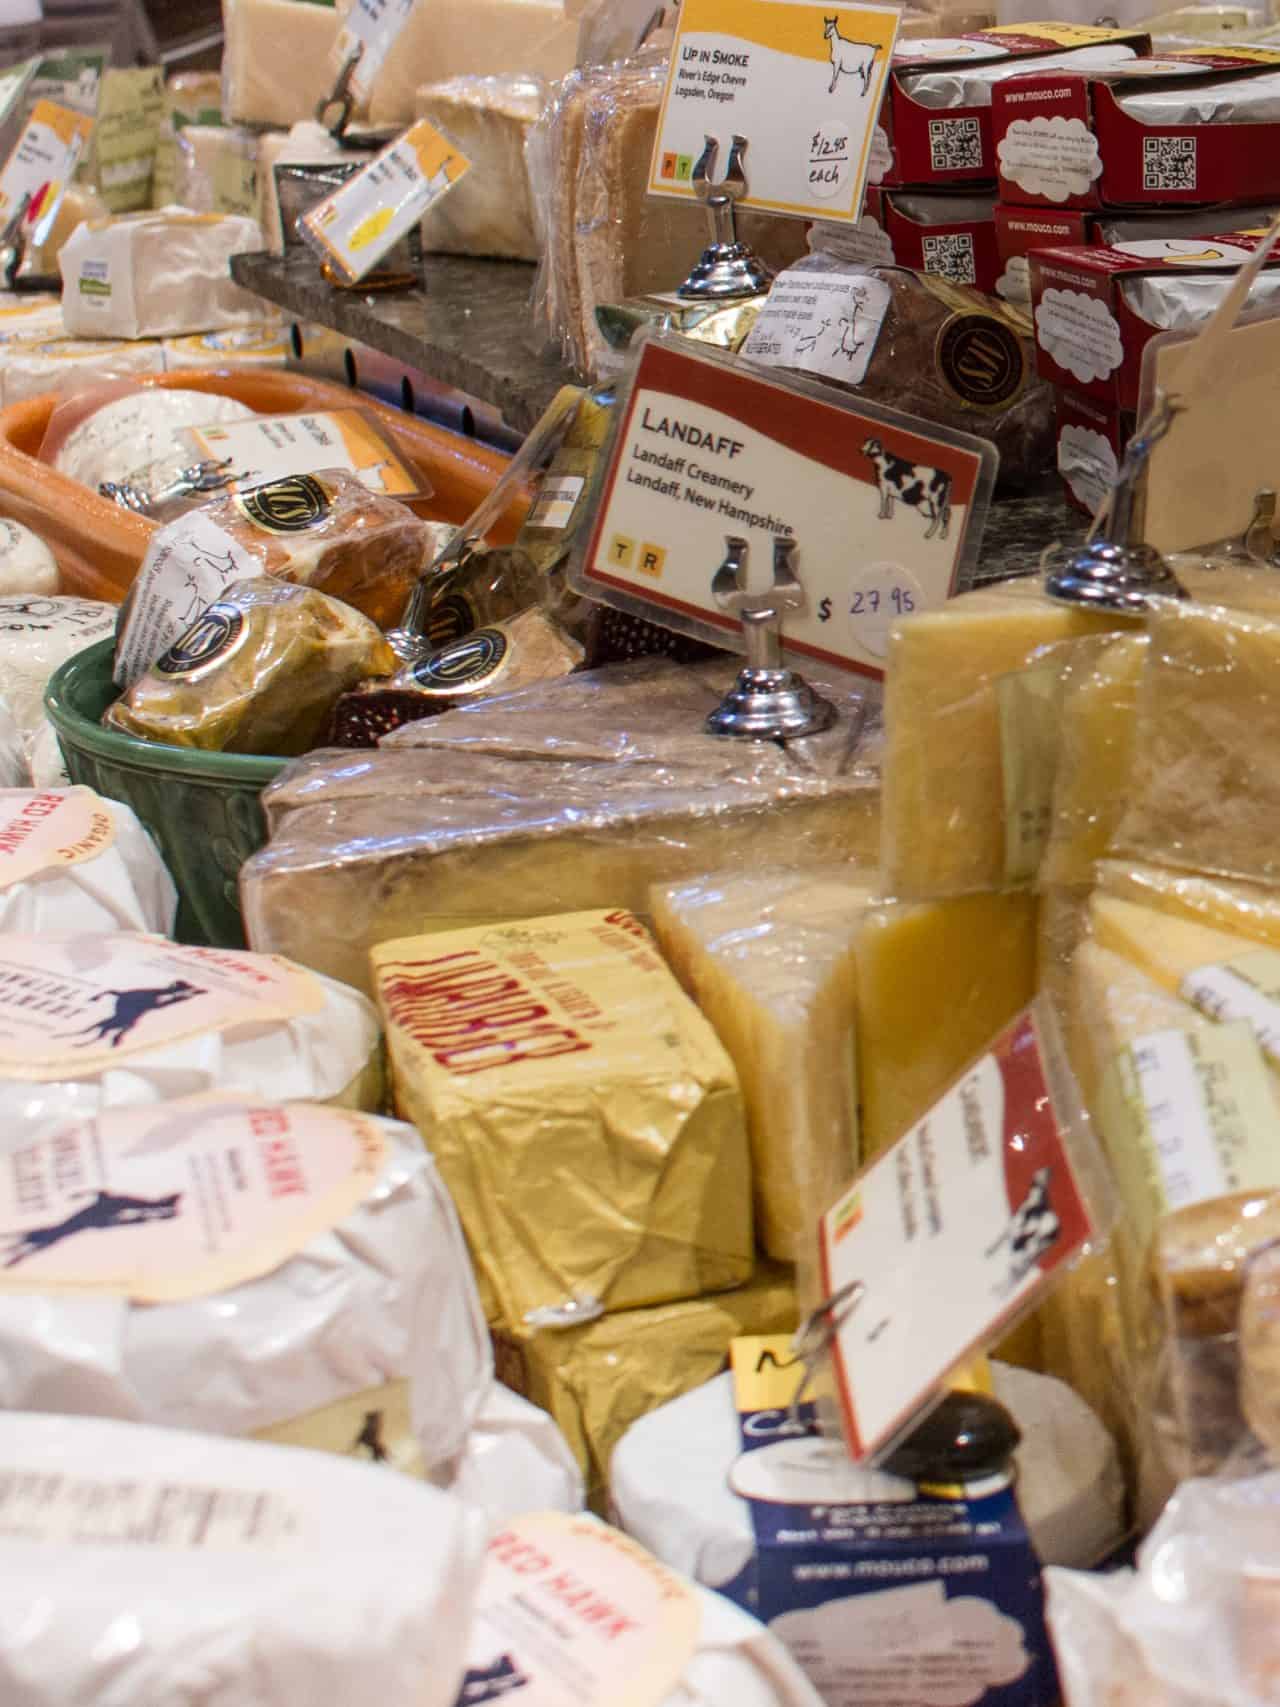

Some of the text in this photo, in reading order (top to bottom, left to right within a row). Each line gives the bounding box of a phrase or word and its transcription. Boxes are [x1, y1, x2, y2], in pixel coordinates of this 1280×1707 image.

[1004, 88, 1072, 103] www.mouco.com
[809, 165, 840, 183] each
[1008, 221, 1071, 235] www.mouco.com
[640, 407, 745, 459] LANDAFF
[632, 443, 755, 501] Landaff Creamery
[626, 467, 794, 538] Landaff, New Hampshire
[615, 542, 657, 571] T R
[817, 597, 833, 622] $
[21, 793, 65, 816] RED
